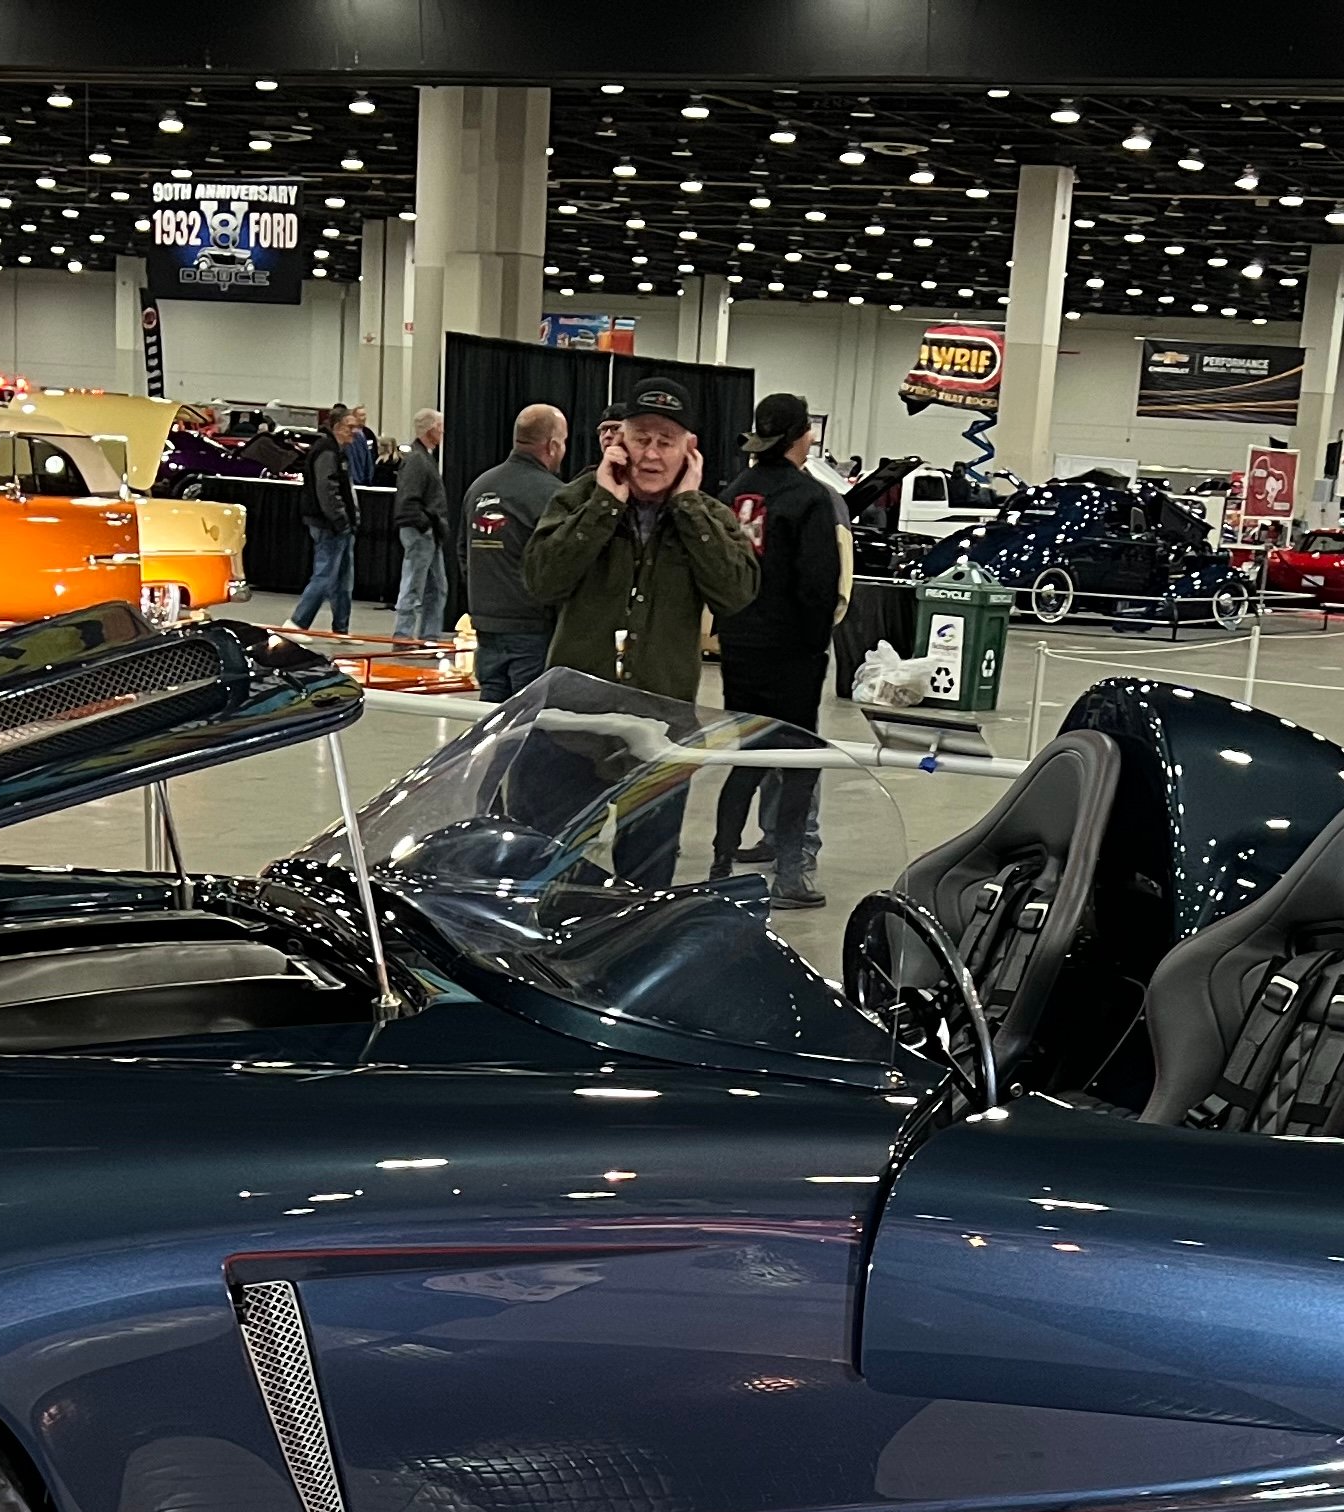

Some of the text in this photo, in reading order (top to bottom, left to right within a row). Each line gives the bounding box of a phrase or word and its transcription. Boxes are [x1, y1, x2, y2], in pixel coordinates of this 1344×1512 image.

[152, 182, 298, 206] 90TH ANNIVERSARY
[152, 209, 202, 246] 1932
[249, 212, 299, 248] FORD
[931, 345, 992, 373] WRIF
[1202, 356, 1270, 369] PERFORMANCE
[925, 588, 972, 600] RECYCLE
